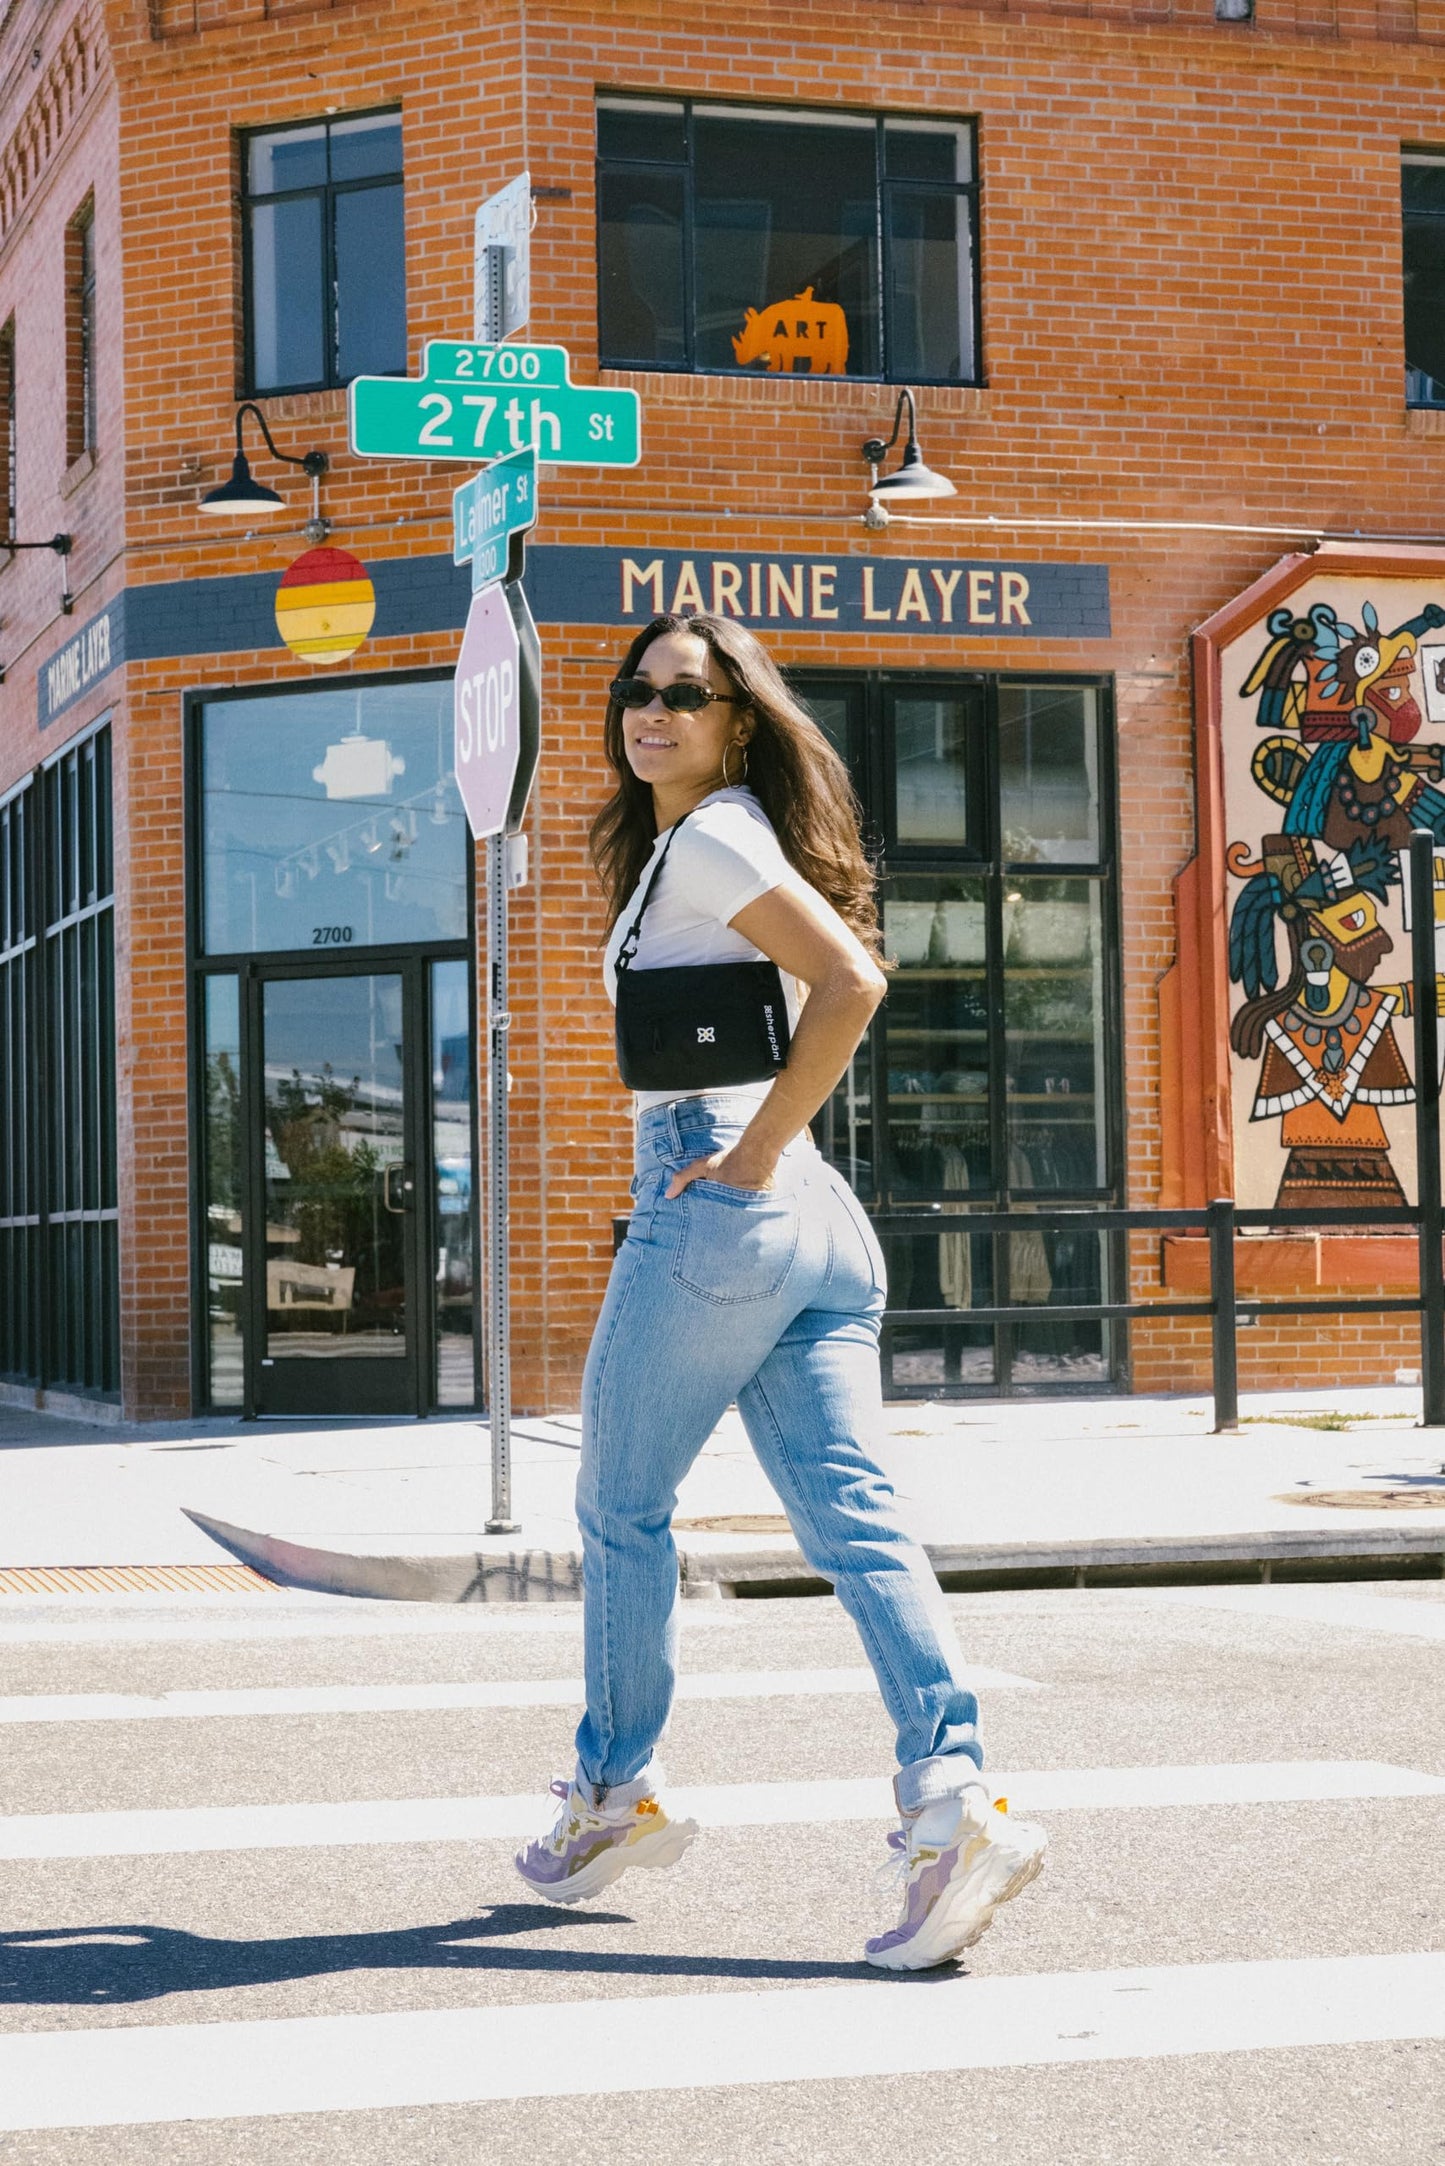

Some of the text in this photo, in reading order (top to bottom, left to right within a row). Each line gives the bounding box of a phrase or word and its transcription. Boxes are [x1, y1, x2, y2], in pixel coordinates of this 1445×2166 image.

[773, 320, 827, 339] ART
[455, 349, 541, 380] 2700
[417, 392, 615, 451] 27th St
[516, 474, 529, 504] St
[620, 558, 1032, 626] MARINE LAYER
[460, 659, 514, 764] STOP
[312, 926, 353, 945] 2700
